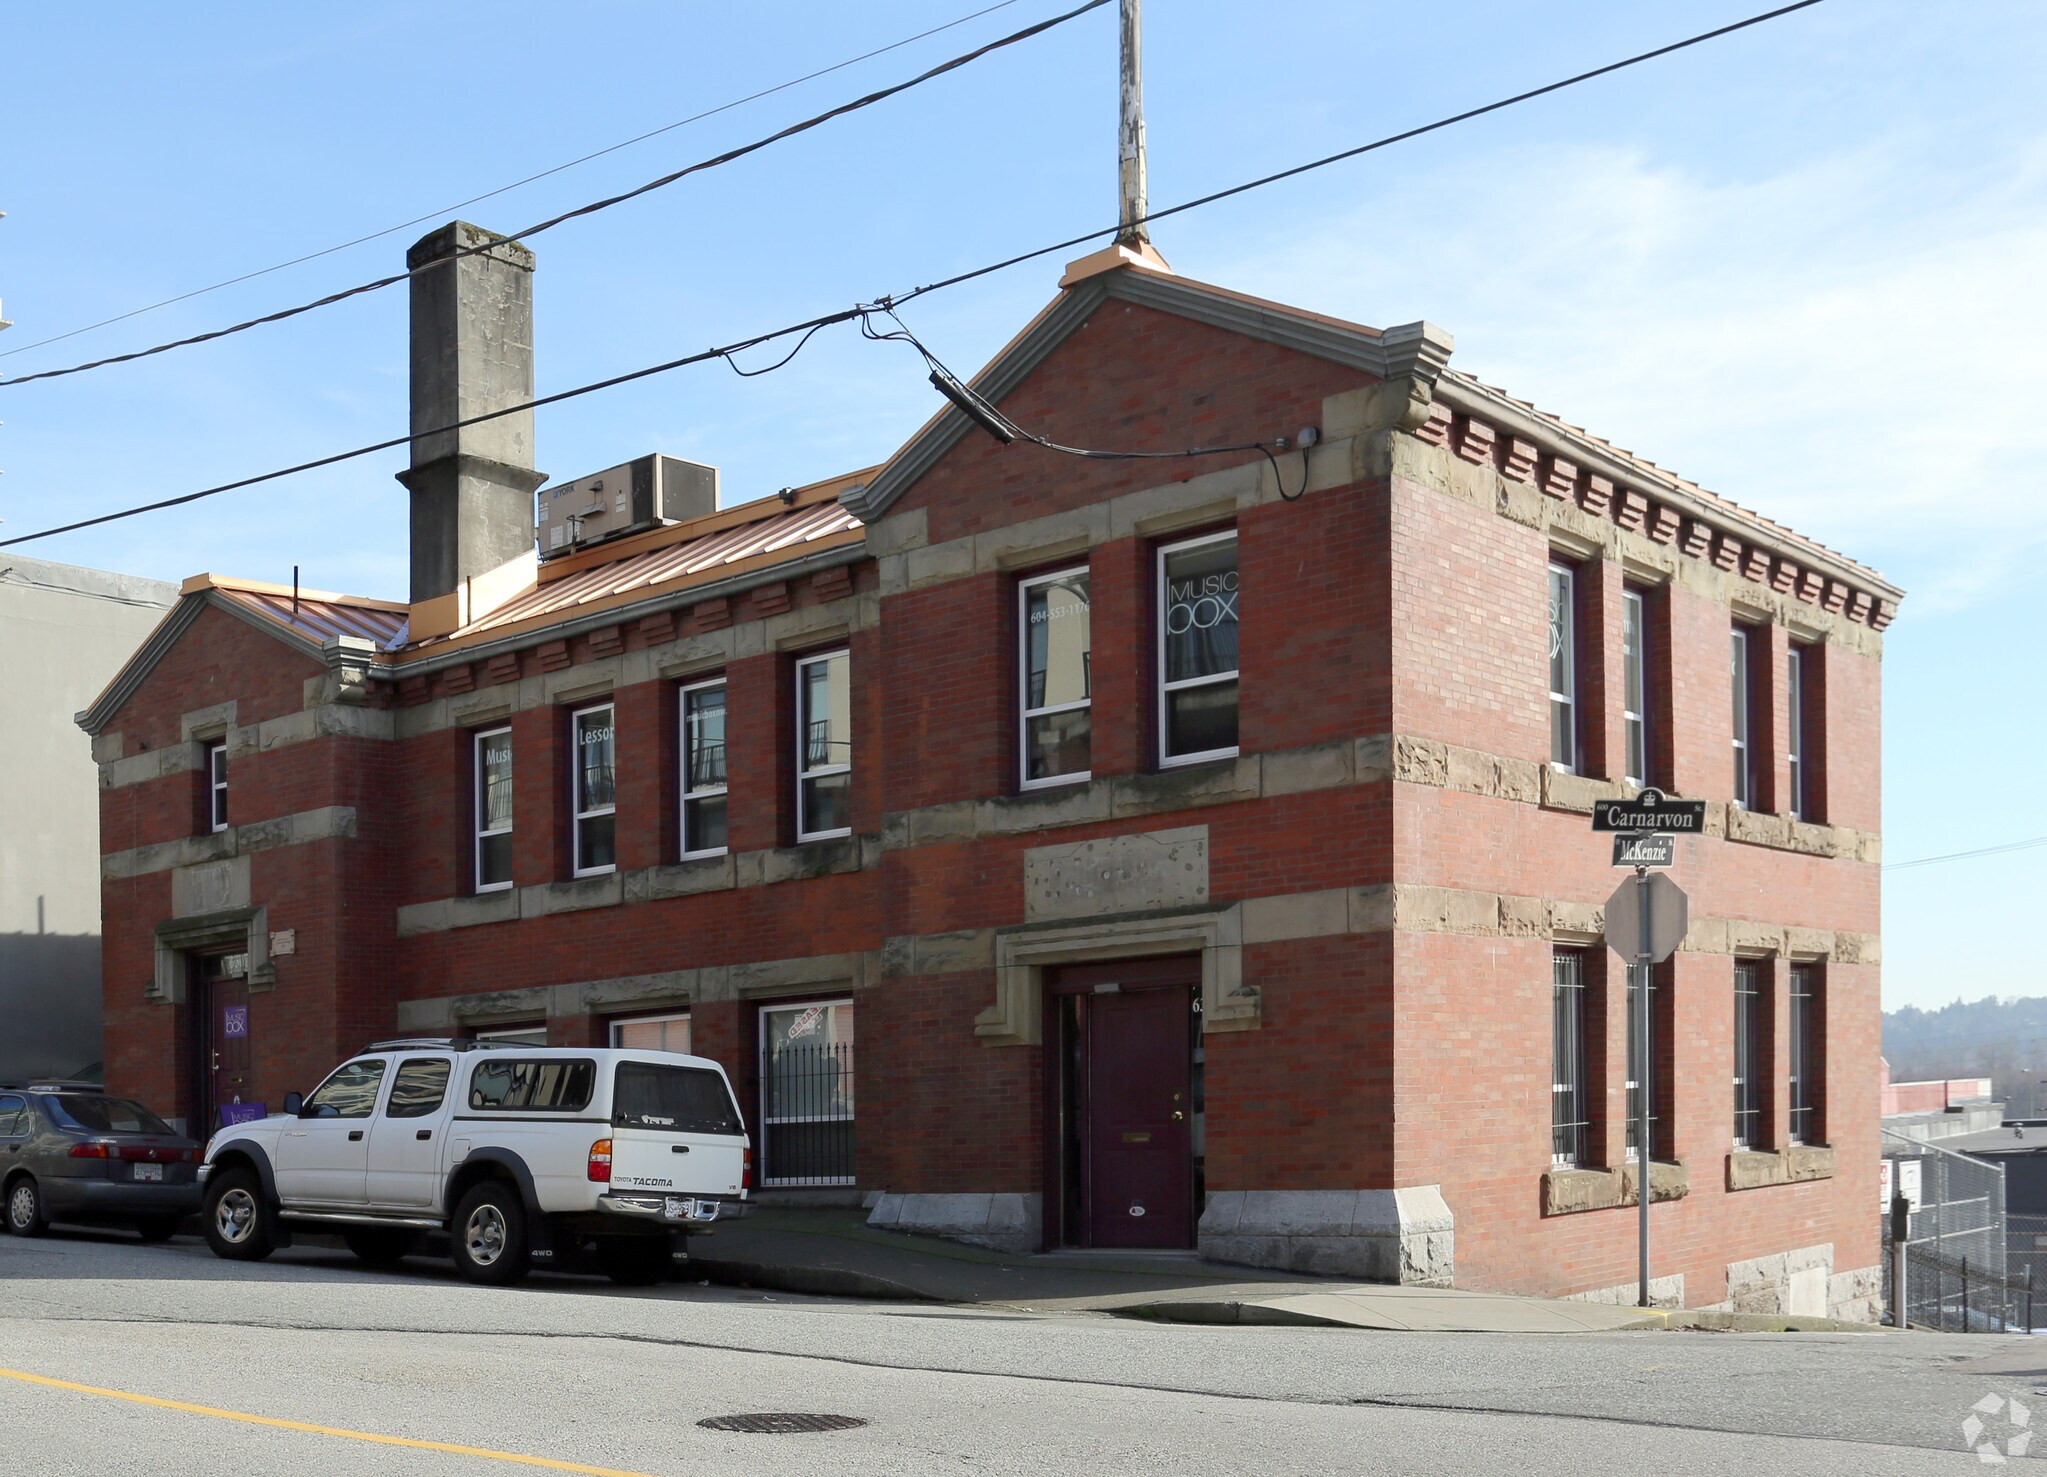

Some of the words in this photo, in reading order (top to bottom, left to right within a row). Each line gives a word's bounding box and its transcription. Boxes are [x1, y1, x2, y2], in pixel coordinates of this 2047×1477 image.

[559, 485, 575, 497] YORK
[1171, 571, 1239, 604] MUSIC
[486, 745, 513, 766] Musi
[1597, 803, 1608, 811] 600
[1607, 806, 1693, 828] Carnarvon
[1694, 804, 1703, 812] St.
[1620, 840, 1667, 861] McKenzie
[633, 1177, 673, 1187] TACOMA
